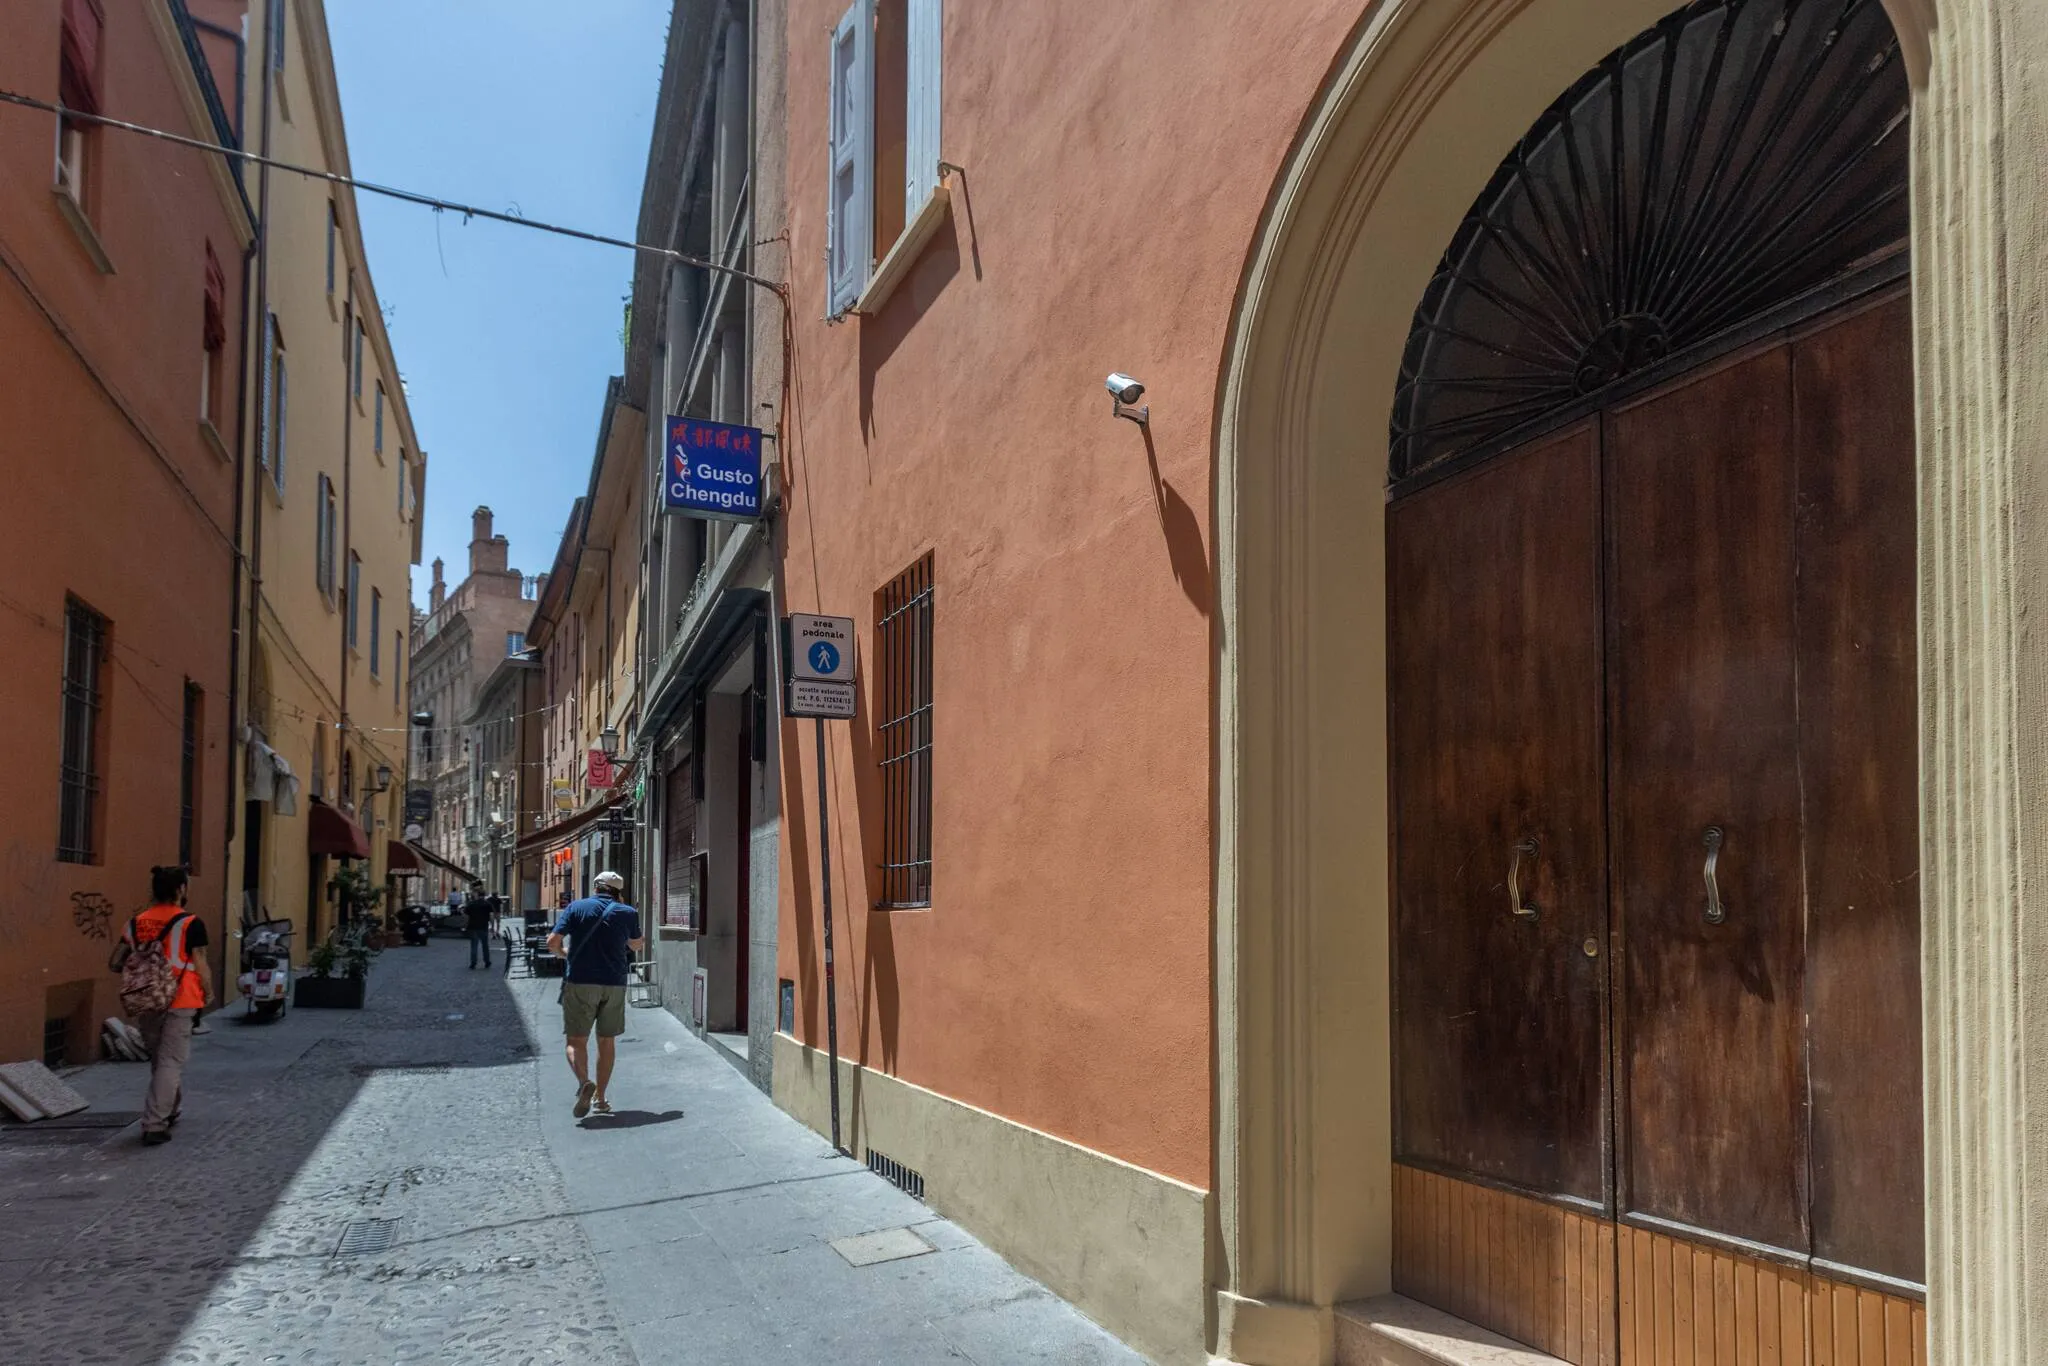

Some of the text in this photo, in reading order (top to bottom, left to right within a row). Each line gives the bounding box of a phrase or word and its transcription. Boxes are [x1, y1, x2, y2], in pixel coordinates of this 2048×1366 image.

[697, 464, 753, 485] Gusto
[671, 482, 756, 508] Chengdu
[813, 620, 833, 629] area
[803, 629, 844, 640] pedonale
